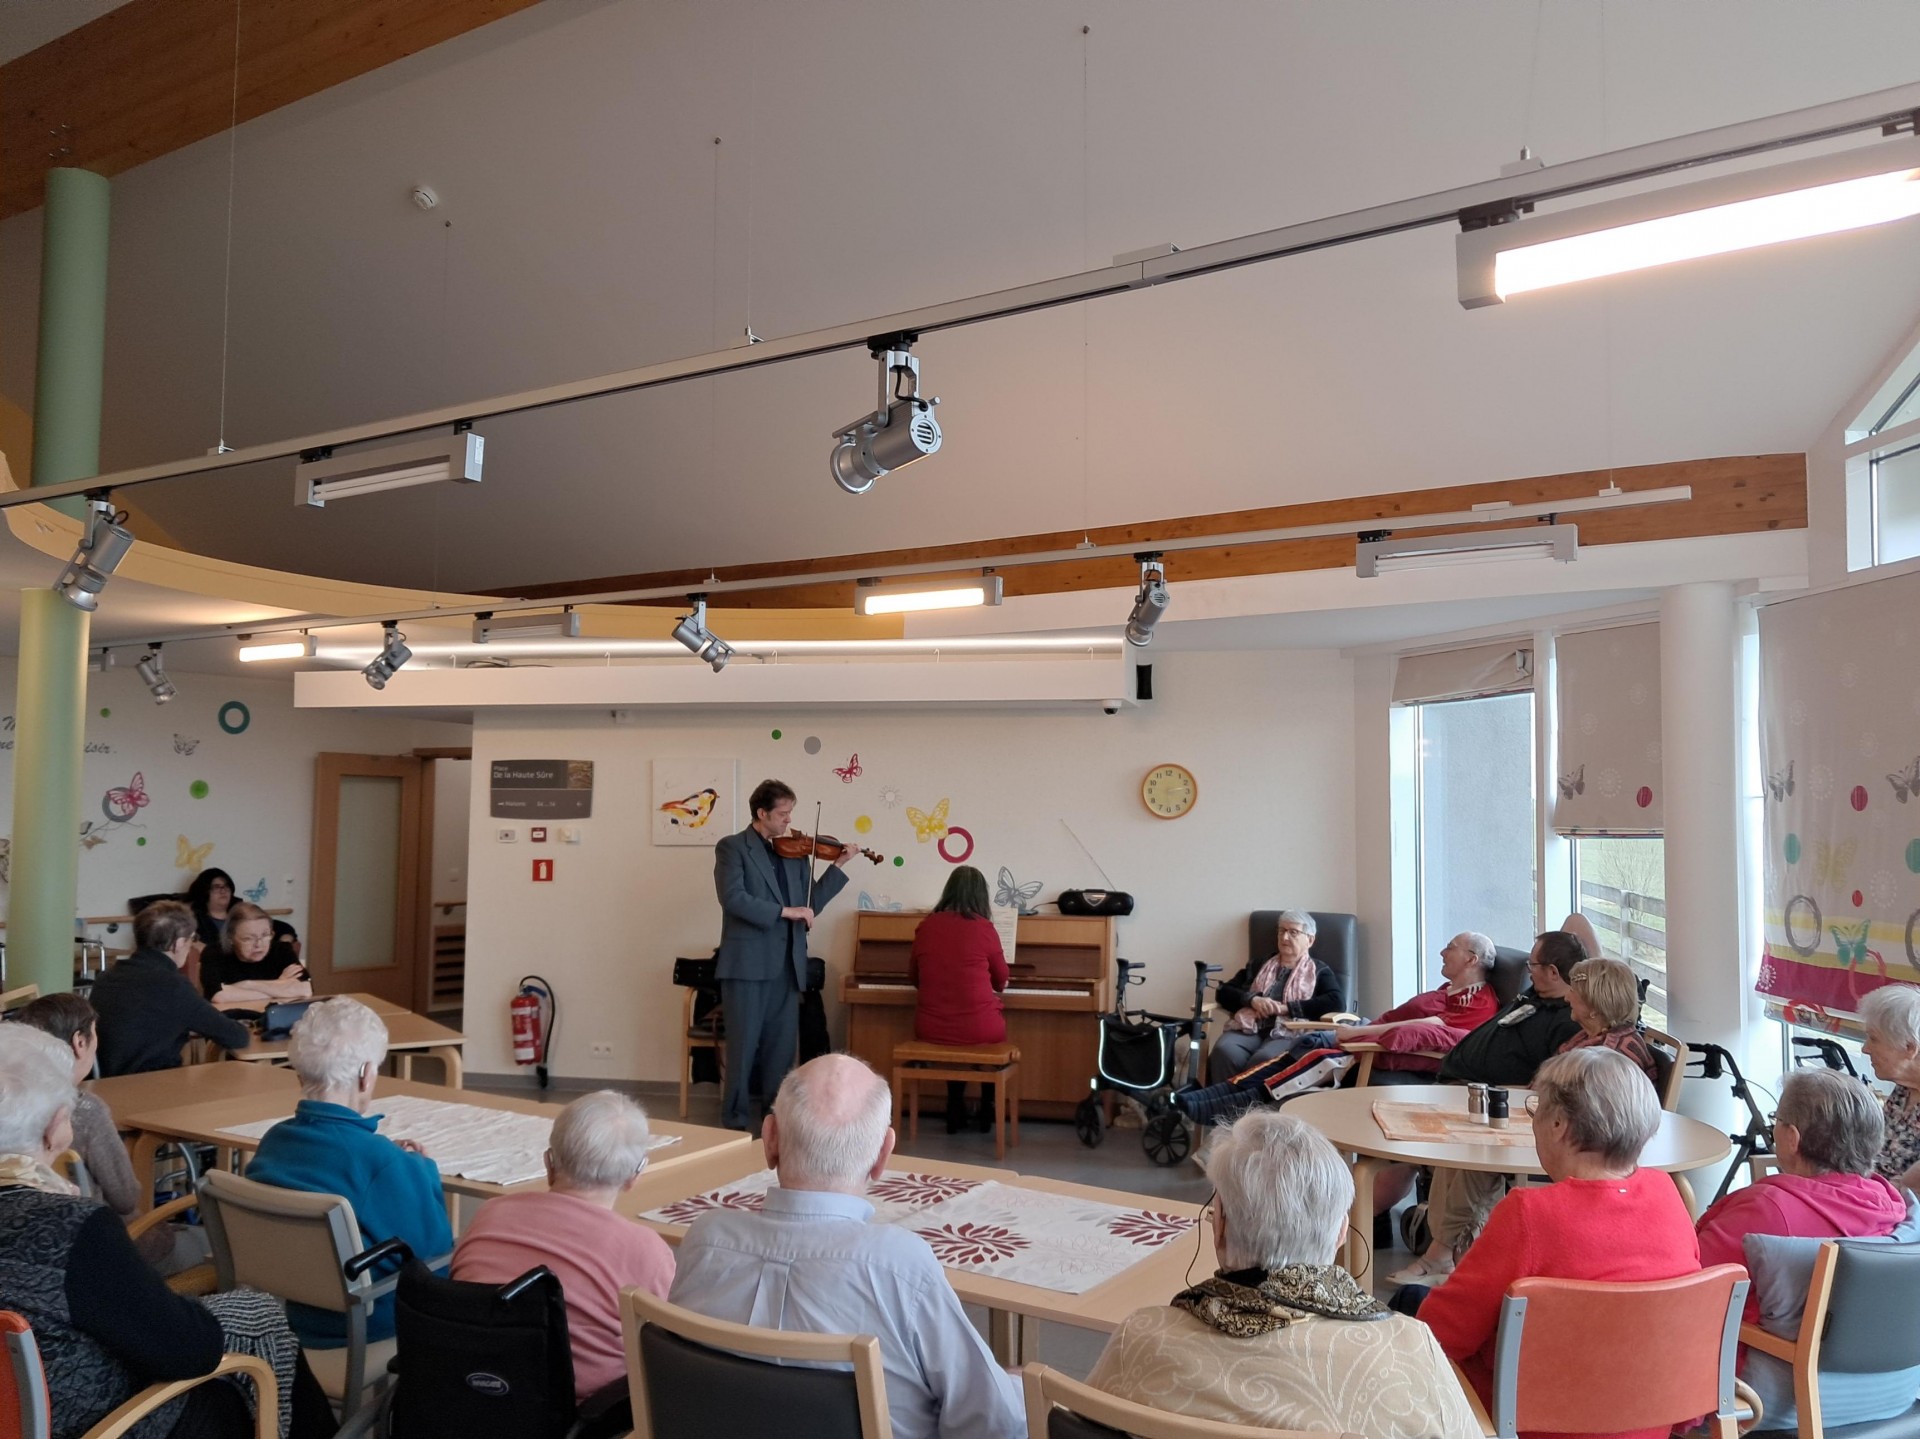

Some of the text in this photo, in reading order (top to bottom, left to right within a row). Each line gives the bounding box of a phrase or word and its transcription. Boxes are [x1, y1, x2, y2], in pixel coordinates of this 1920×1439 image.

[493, 770, 553, 779] De la Haute Sûre
[1165, 769, 1173, 777] 12
